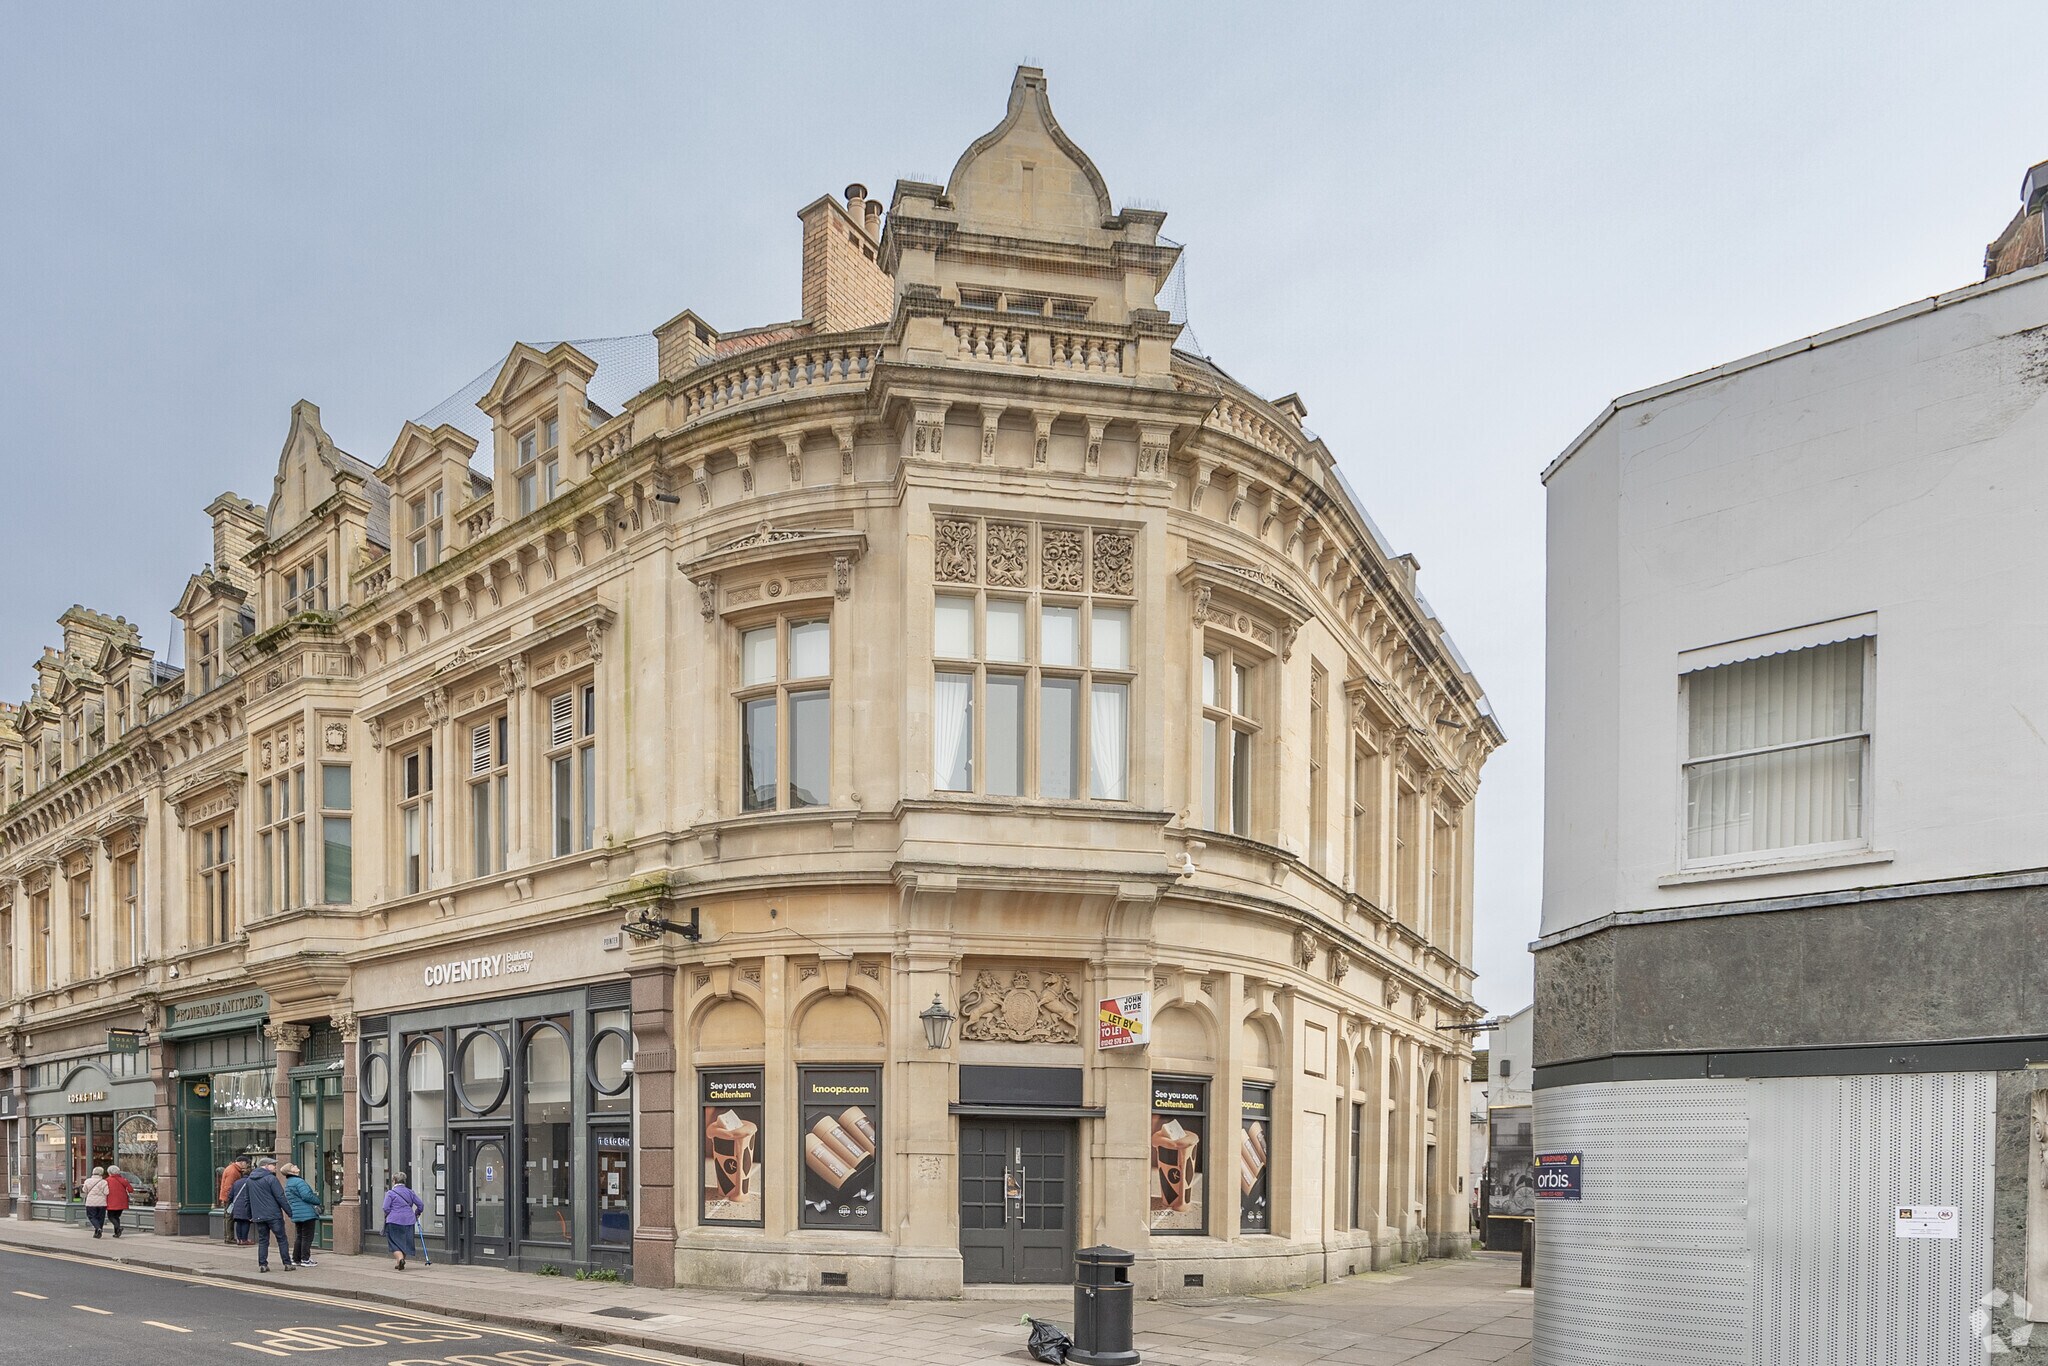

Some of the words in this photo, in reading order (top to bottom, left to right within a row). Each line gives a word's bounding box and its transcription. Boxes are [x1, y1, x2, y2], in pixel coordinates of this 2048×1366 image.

[506, 950, 534, 963] Building
[424, 954, 502, 987] COVENTRY
[506, 962, 532, 974] Society
[1124, 995, 1142, 1005] JOHN
[175, 1002, 220, 1023] PROMENADE
[222, 995, 264, 1014] ANTIQUES
[1124, 1002, 1142, 1012] RYDE
[1108, 1013, 1122, 1025] LET
[1122, 1018, 1134, 1029] BY
[1101, 1027, 1111, 1037] TO
[1111, 1026, 1122, 1036] LET
[710, 1082, 723, 1090] See
[723, 1082, 738, 1091] you
[738, 1082, 757, 1090] soon,
[812, 1084, 869, 1096] knoops.com
[89, 1091, 105, 1101] THAI
[710, 1090, 751, 1099] Cheltenham
[1155, 1090, 1168, 1098] See
[1168, 1091, 1181, 1100] you
[1181, 1092, 1199, 1101] soon,
[1155, 1099, 1194, 1109] Cheltenham
[709, 1200, 731, 1208] KNOOPS
[1153, 1209, 1175, 1218] KNOOPS
[255, 1322, 482, 1351] STOP
